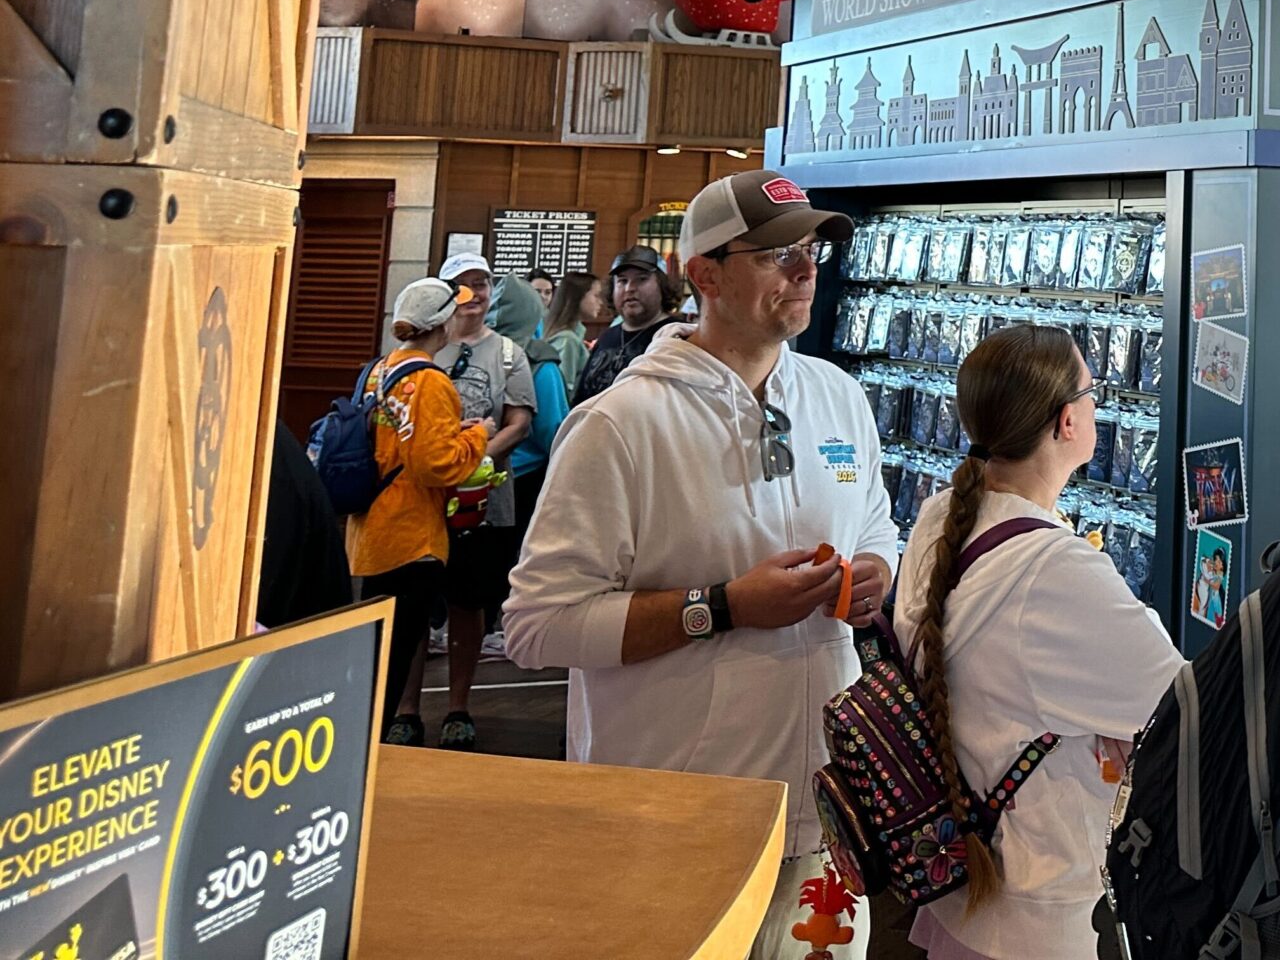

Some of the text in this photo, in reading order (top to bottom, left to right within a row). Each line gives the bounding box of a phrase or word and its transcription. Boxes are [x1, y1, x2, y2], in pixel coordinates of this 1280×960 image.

[504, 210, 588, 220] TICKET PRICES
[32, 734, 142, 798] ELEVATE
[229, 716, 335, 800] $600
[0, 760, 171, 850] YOUR DISNEY
[0, 800, 160, 890] EXPERIENCE
[196, 849, 268, 910] $300
[287, 811, 349, 865] $300
